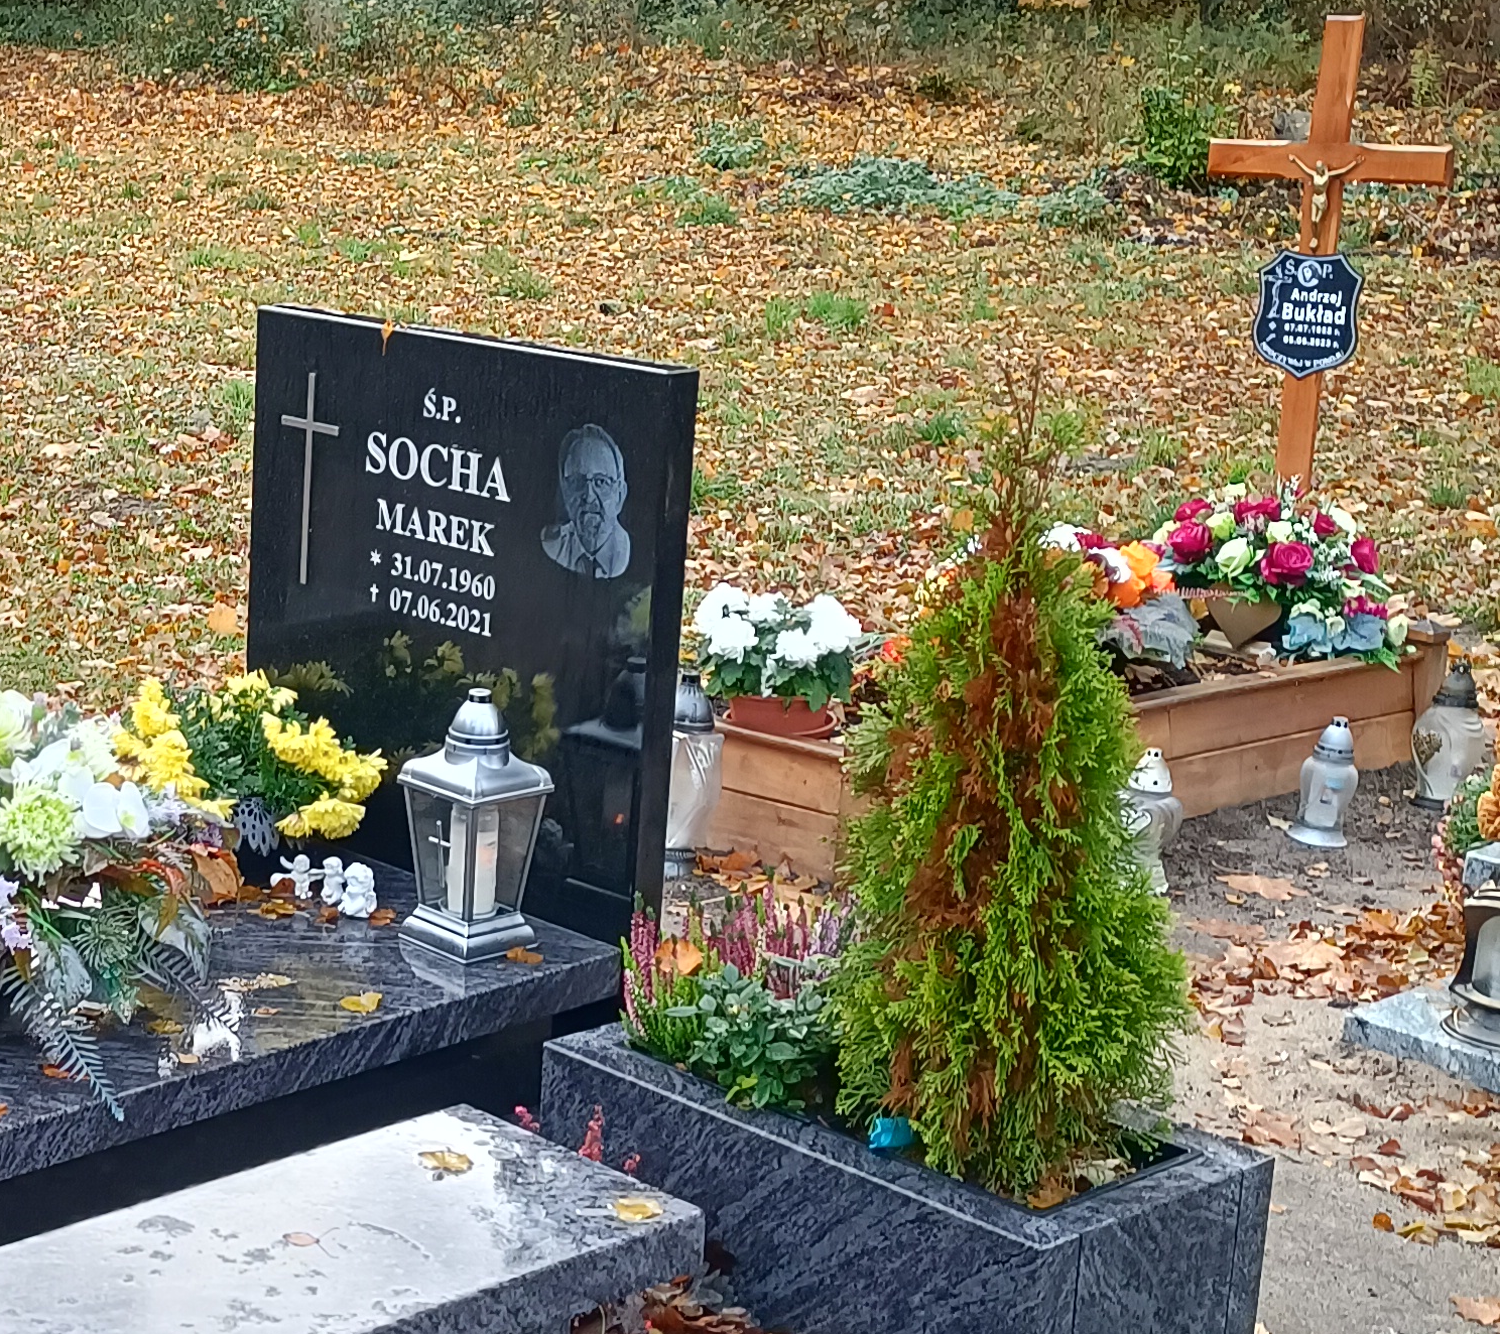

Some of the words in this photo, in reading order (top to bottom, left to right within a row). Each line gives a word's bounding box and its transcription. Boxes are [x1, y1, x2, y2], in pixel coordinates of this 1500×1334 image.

[1282, 302, 1347, 325] Bukład
[1290, 287, 1342, 307] Andrzej
[422, 388, 461, 423] Ś.P.
[365, 431, 511, 502] SOCHA
[375, 498, 495, 557] MAREK
[390, 553, 496, 600] 31.07.1960
[389, 587, 492, 637] 07.06.2021
